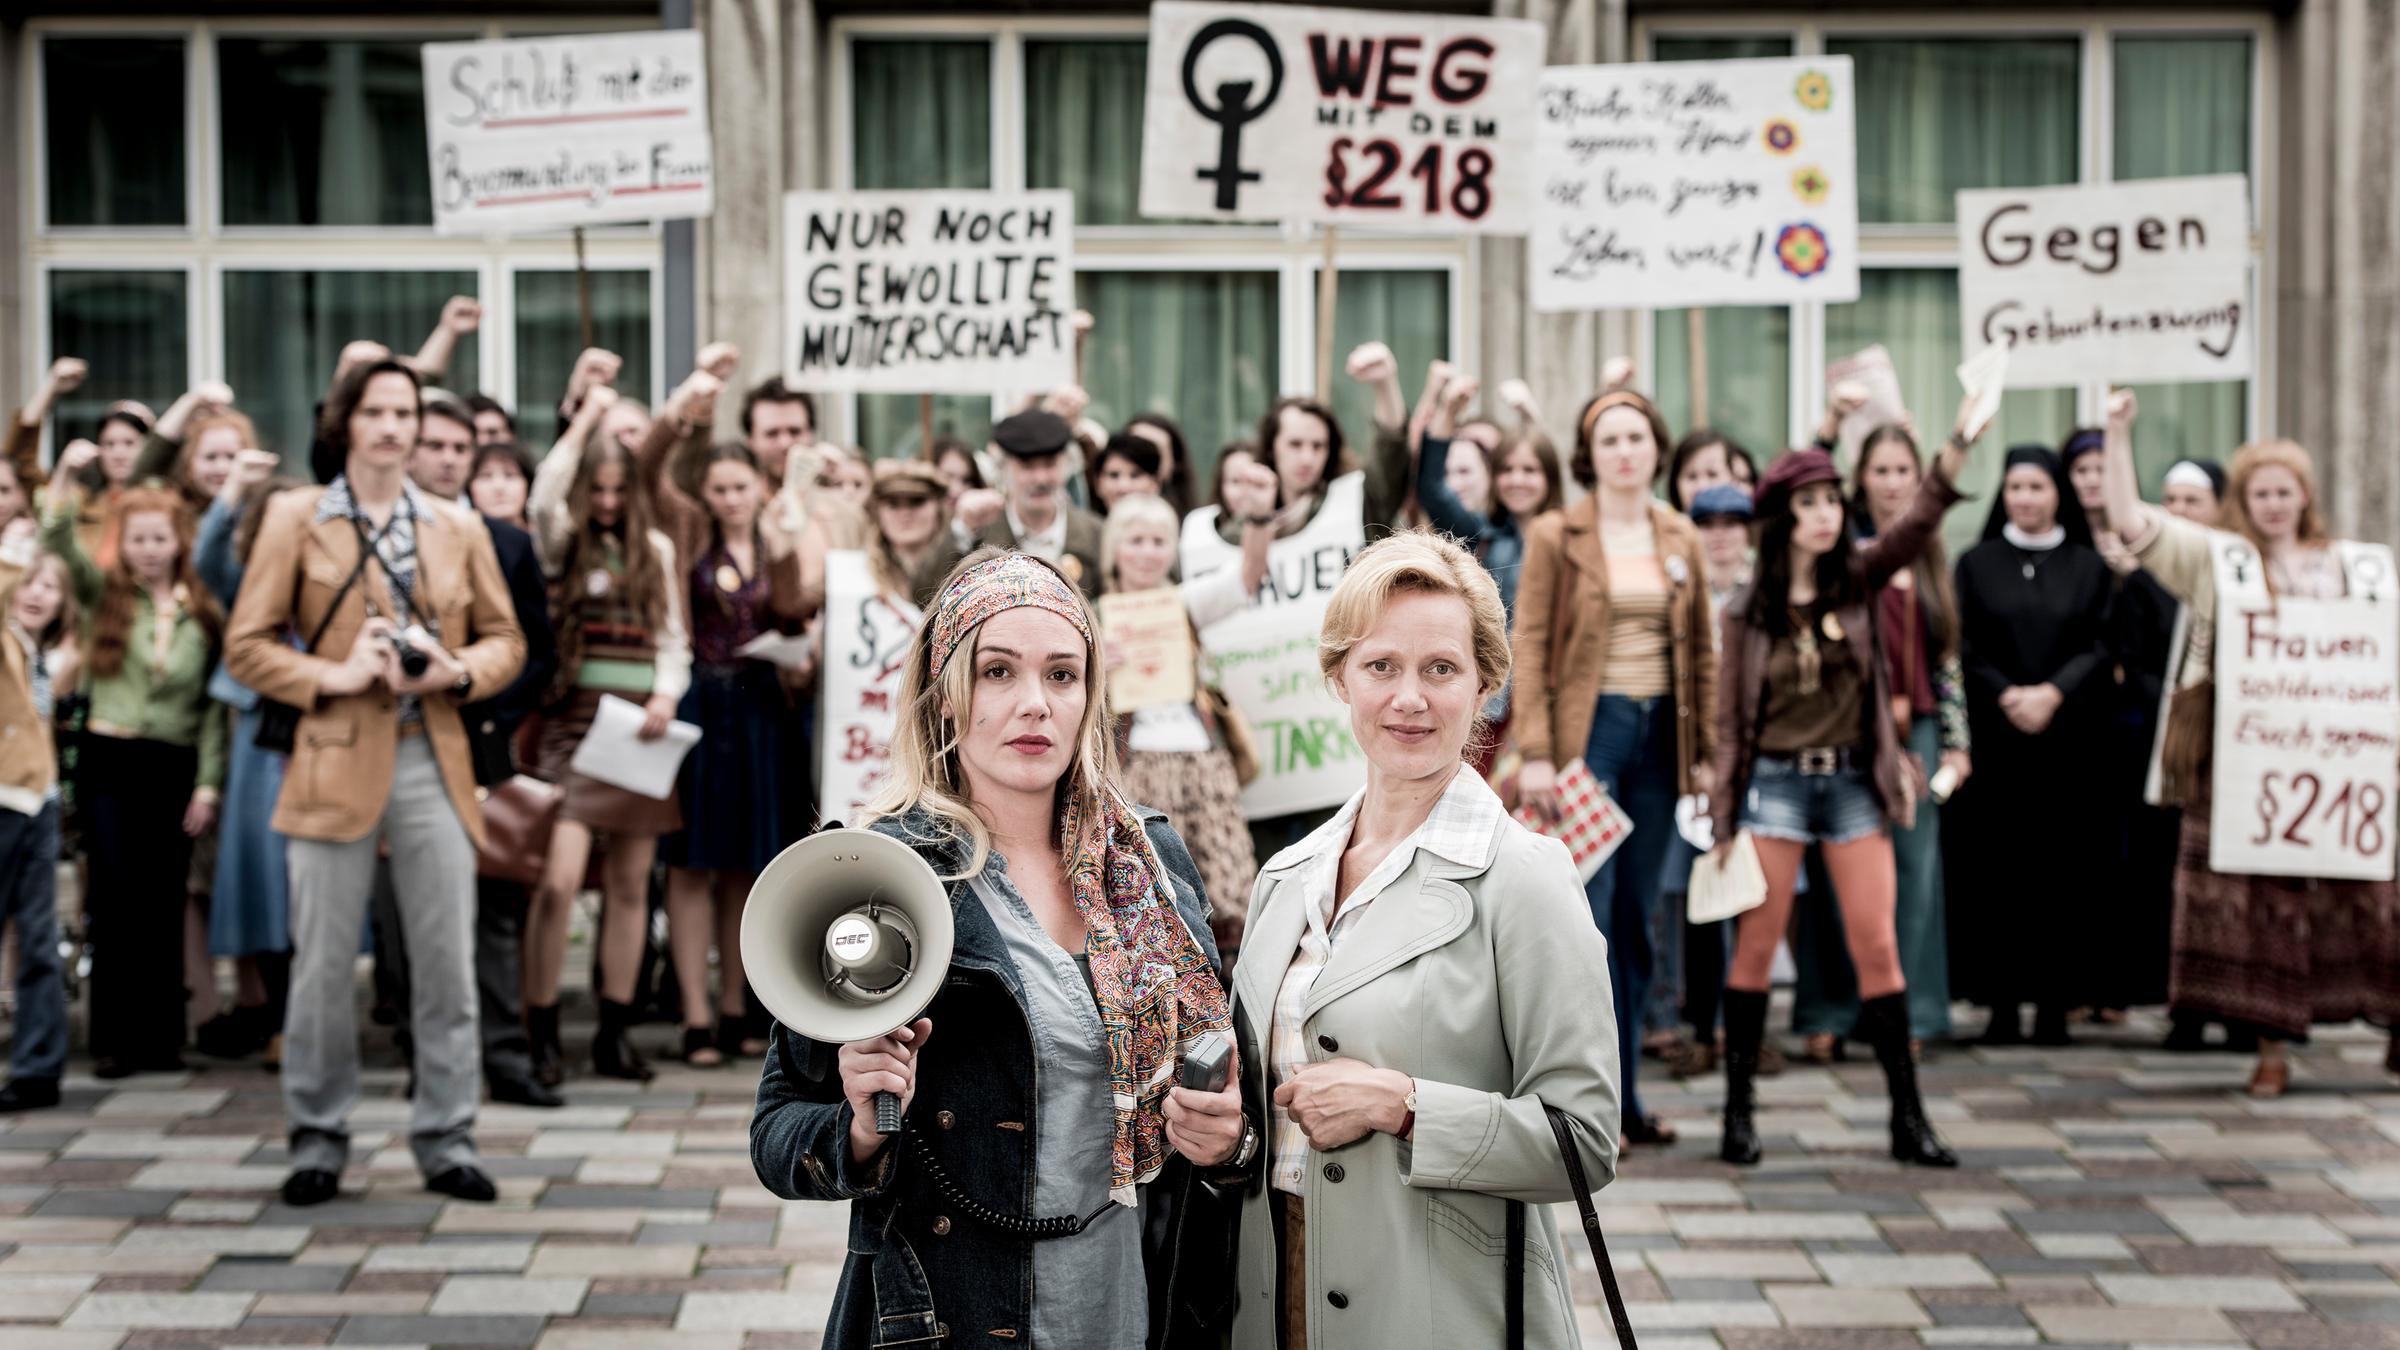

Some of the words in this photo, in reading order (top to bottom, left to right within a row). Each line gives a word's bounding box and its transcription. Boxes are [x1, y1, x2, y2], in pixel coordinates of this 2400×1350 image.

[1307, 33, 1496, 106] WEG
[1316, 107, 1384, 128] MIT
[1410, 112, 1497, 138] DEM
[1323, 137, 1494, 219] §218
[806, 207, 905, 253] NUR
[934, 208, 1052, 243] NOCH
[1981, 202, 2206, 275] Gegen
[807, 255, 1056, 311] GEWOLLTE
[800, 311, 1063, 372] MUTTERSCHAFT
[2238, 608, 2379, 659] Frauen
[2251, 771, 2384, 856] §218
